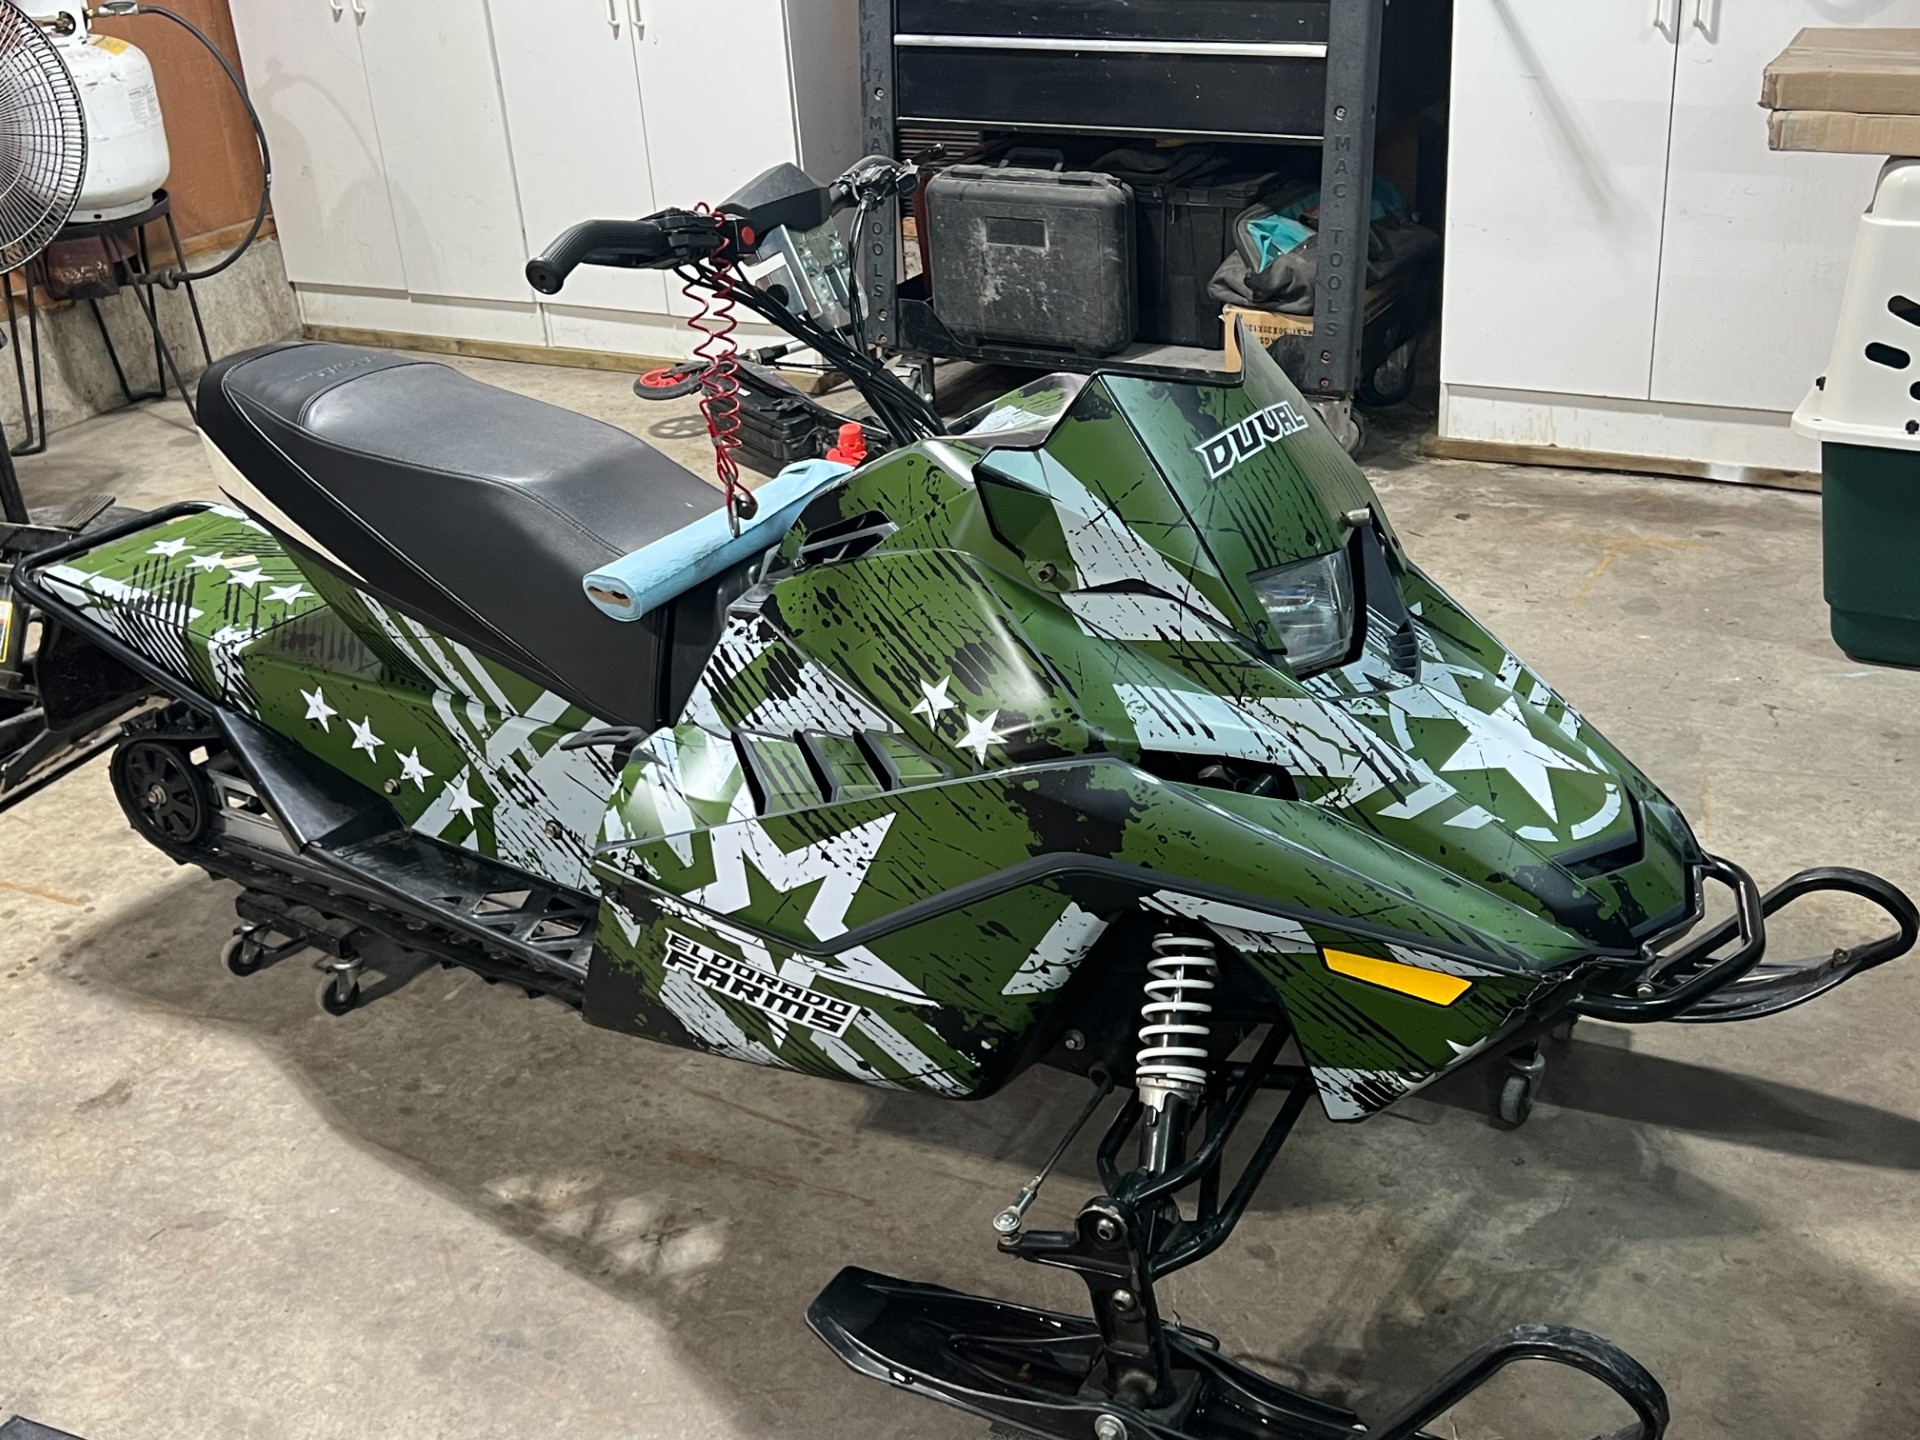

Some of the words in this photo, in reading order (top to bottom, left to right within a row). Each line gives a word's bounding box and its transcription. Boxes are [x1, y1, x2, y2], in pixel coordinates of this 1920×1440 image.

[869, 116, 883, 151] MA
[1332, 135, 1351, 199] MAC
[872, 208, 884, 298] OOLS
[1325, 228, 1344, 337] TOOLS
[1197, 402, 1308, 477] DUVAL
[665, 951, 846, 1034] FARMS
